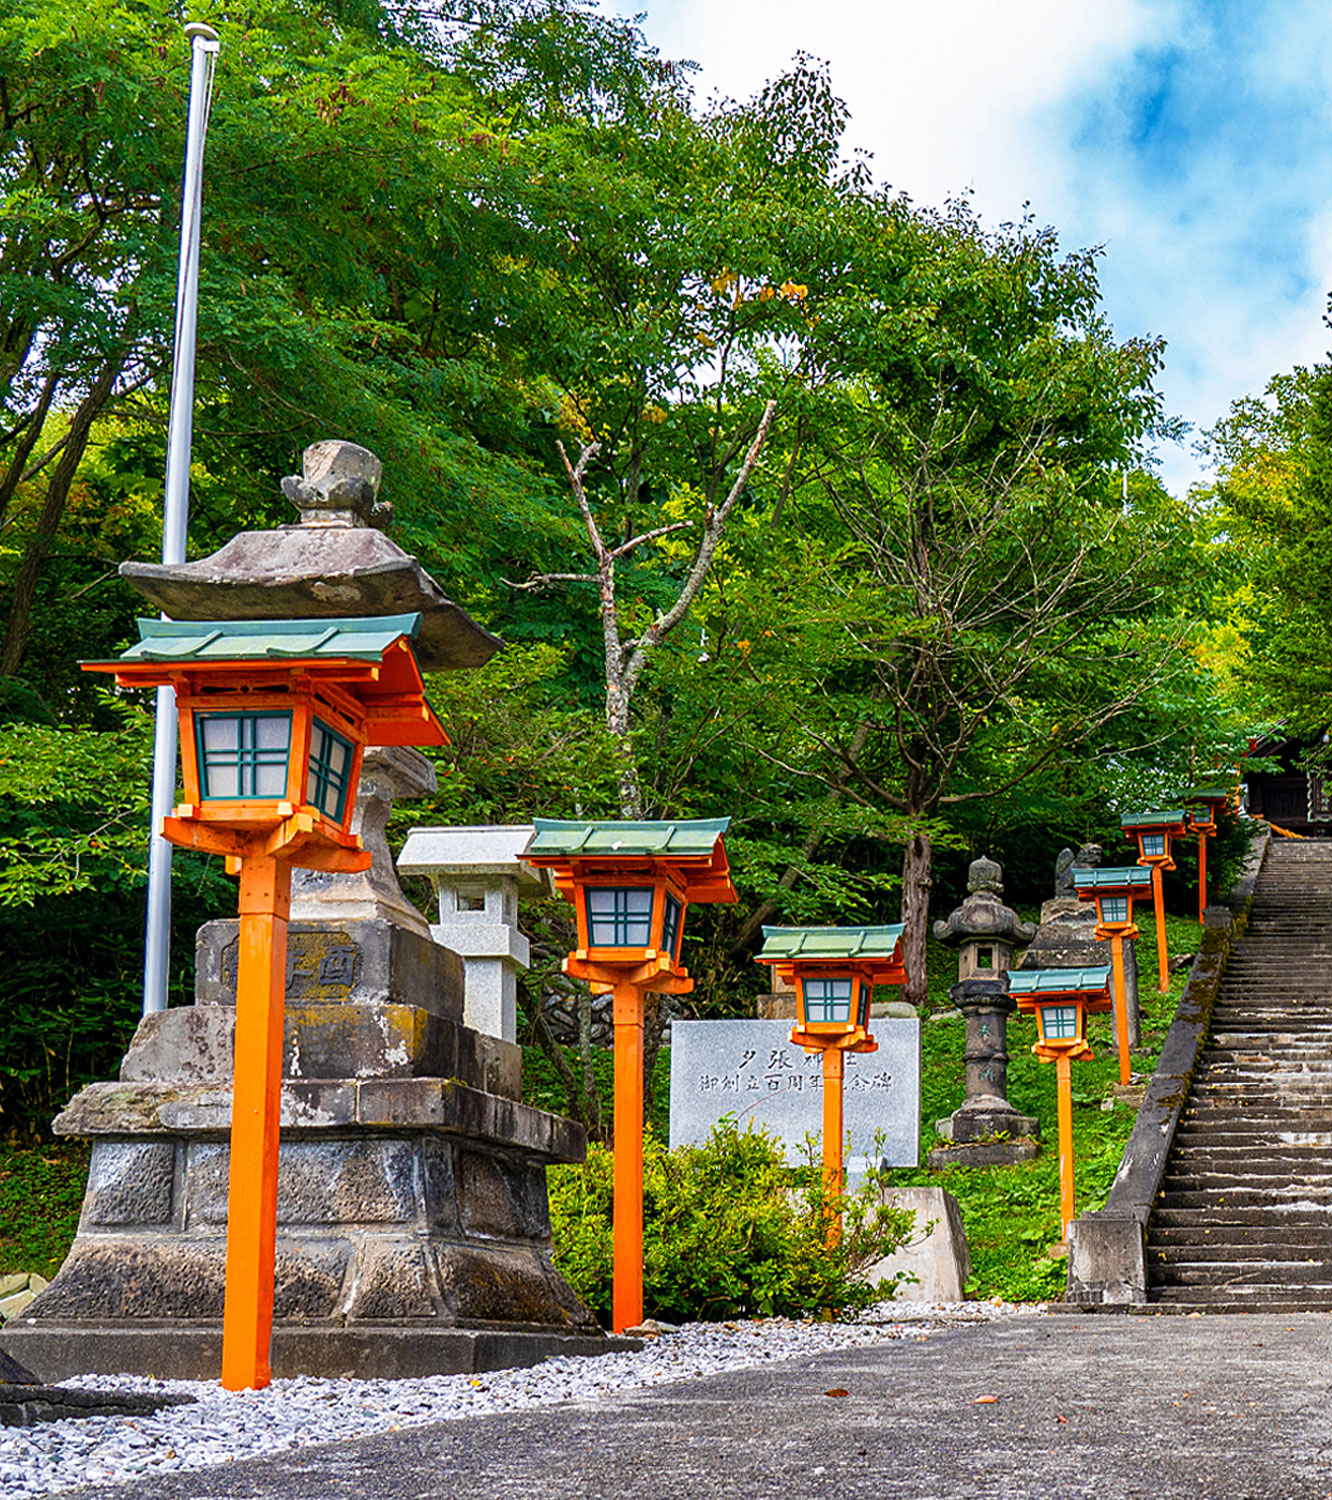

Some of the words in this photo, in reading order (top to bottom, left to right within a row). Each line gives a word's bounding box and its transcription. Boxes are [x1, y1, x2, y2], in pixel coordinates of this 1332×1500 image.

[698, 1072, 892, 1092] 御創立百周年念碑
